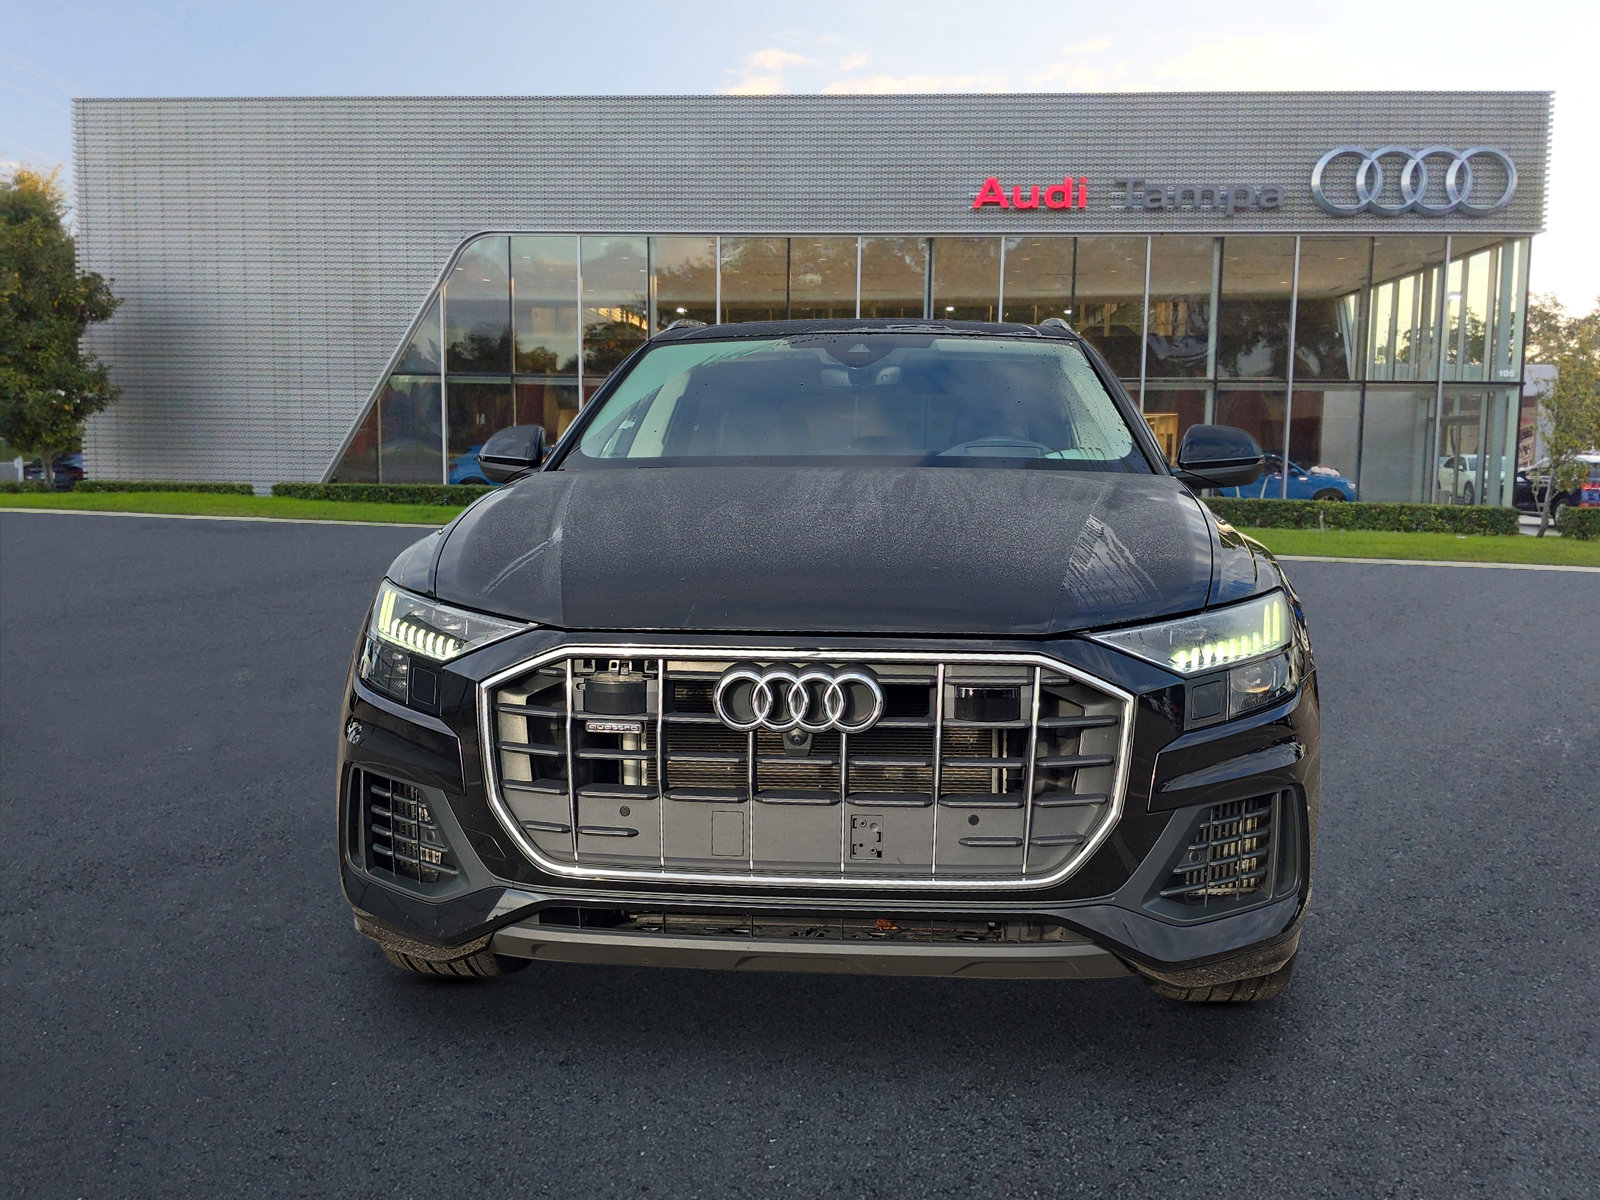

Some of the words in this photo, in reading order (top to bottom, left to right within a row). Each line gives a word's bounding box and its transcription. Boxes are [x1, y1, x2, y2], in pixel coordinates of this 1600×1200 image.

[972, 177, 1088, 210] Audi
[1115, 177, 1285, 217] Tampa
[1498, 369, 1515, 378] 105
[587, 722, 640, 732] quattro
